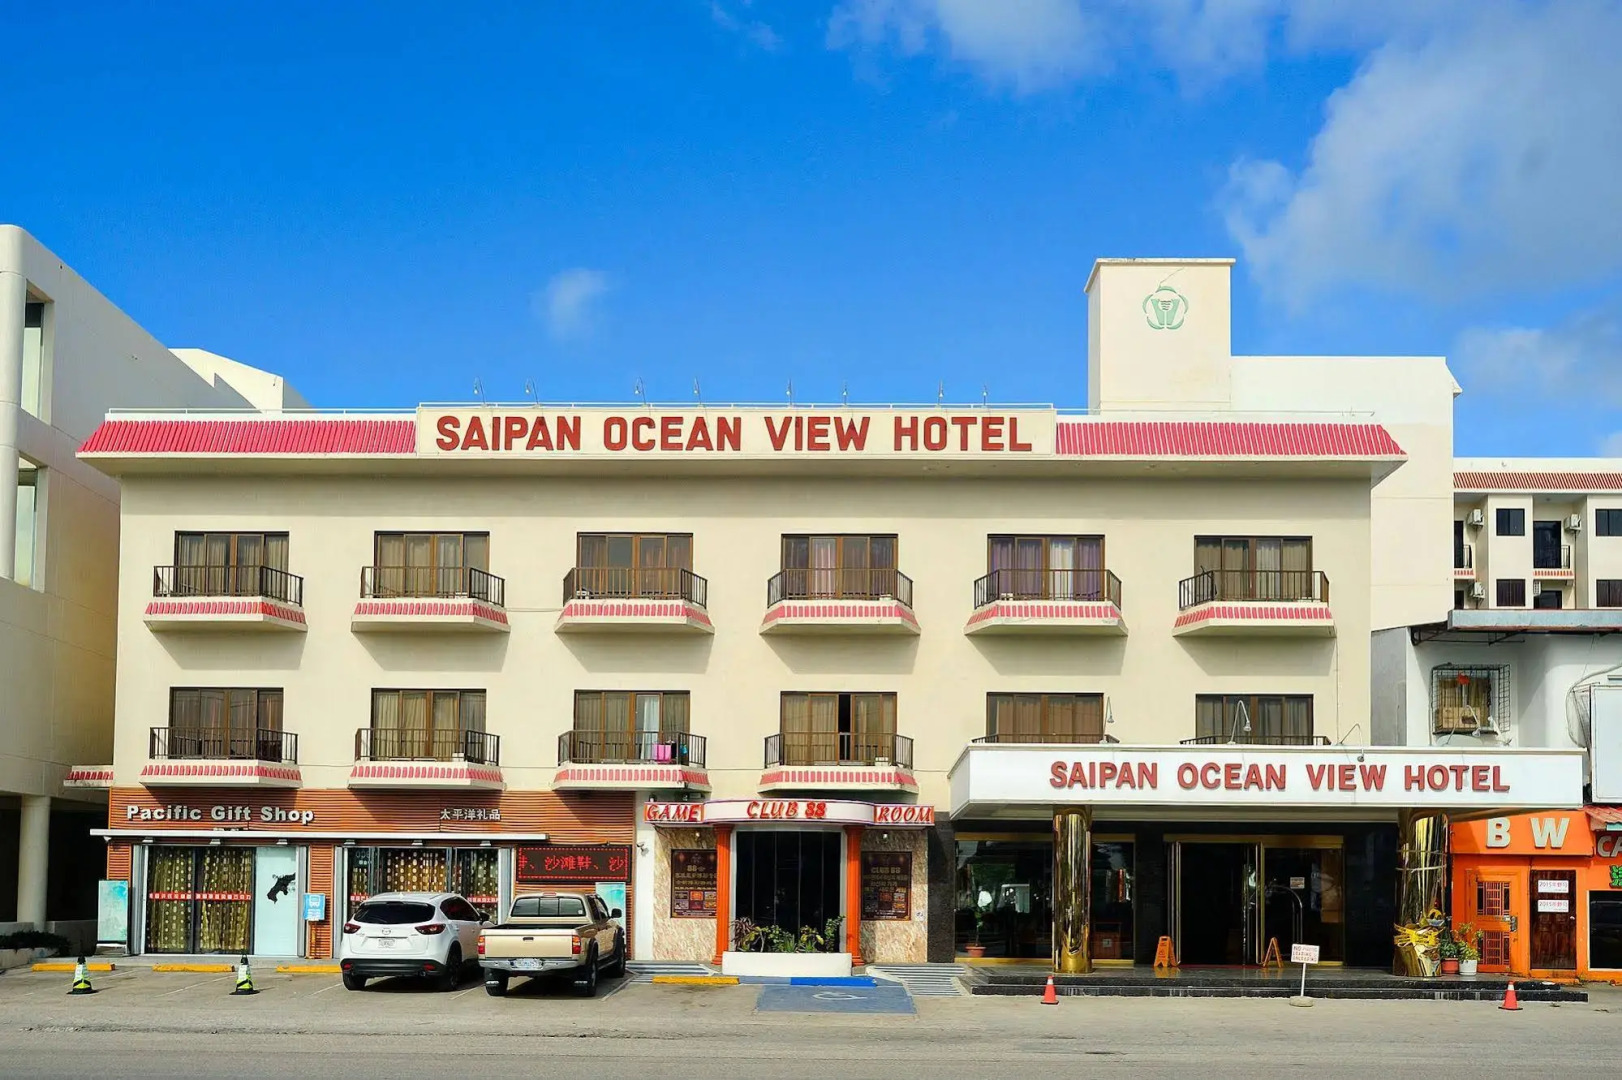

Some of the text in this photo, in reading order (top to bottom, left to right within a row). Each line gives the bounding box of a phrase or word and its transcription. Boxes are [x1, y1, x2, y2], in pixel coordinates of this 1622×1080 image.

[436, 416, 1032, 453] SAIPAN OCEAN VIEW HOTEL
[1050, 761, 1510, 792] SAIPAN OCEAN VIEW HOTEL
[126, 805, 314, 825] Pacific Gift Shop
[440, 808, 501, 821] 太平洋礼品
[647, 803, 701, 822] GAME
[747, 801, 827, 819] CLUB 88
[877, 805, 933, 824] ROOM
